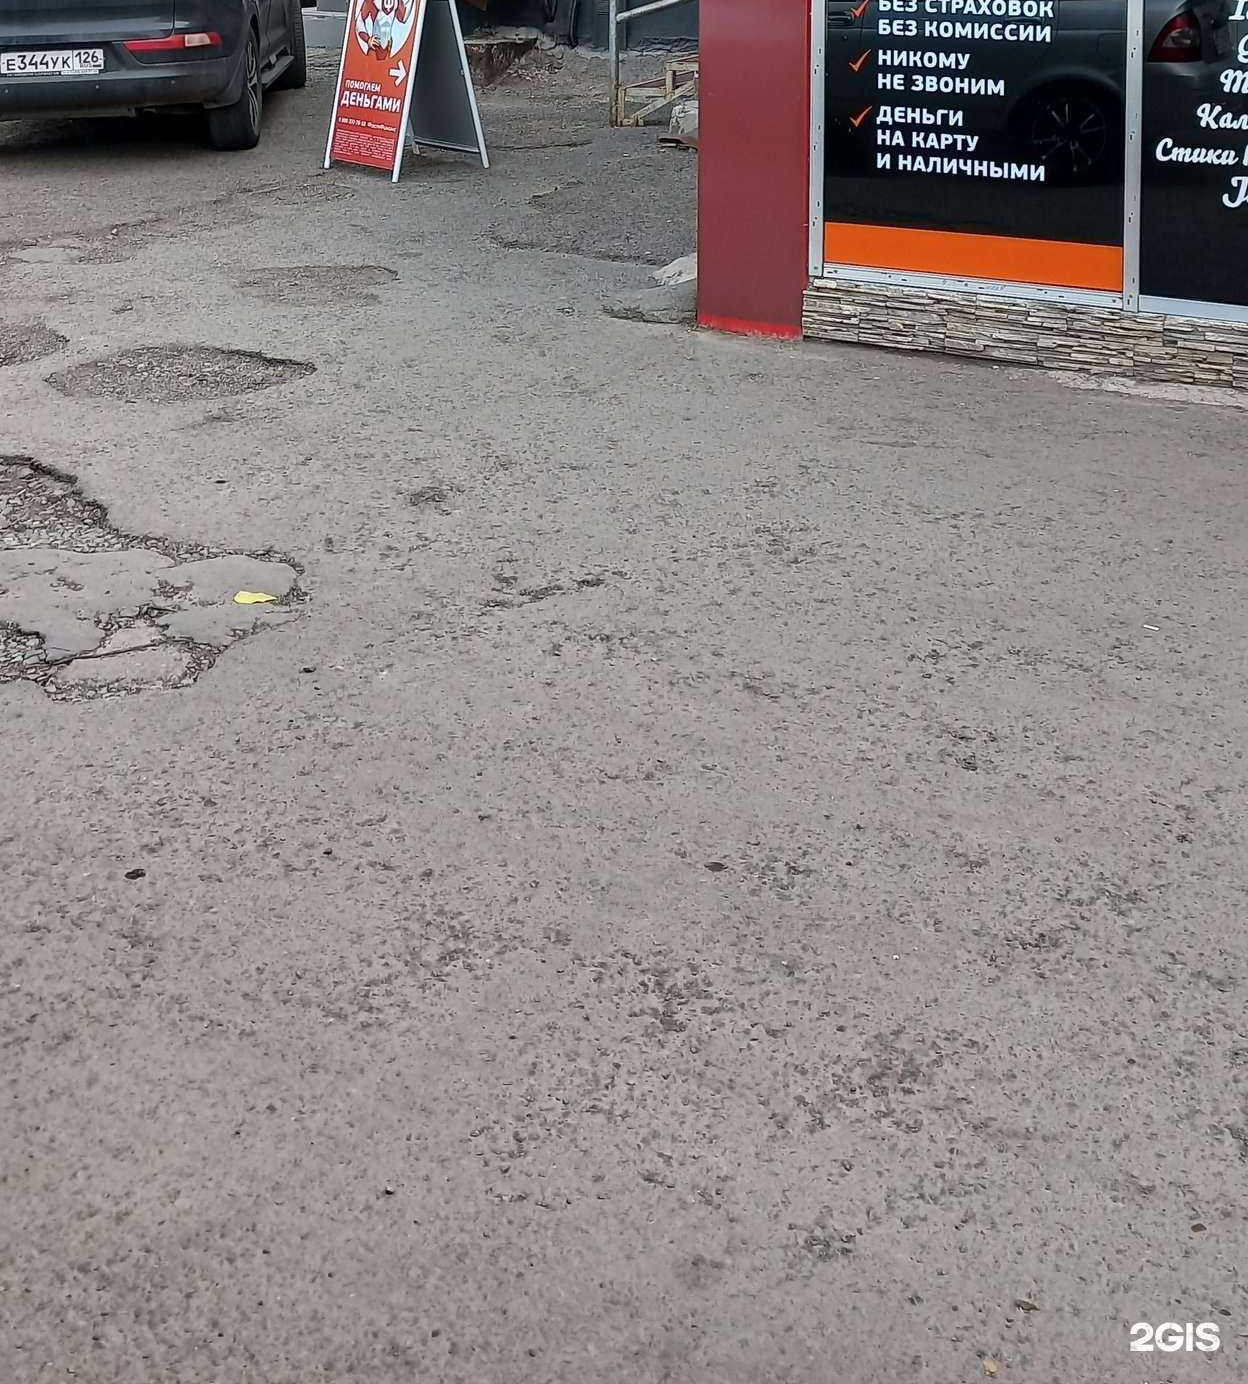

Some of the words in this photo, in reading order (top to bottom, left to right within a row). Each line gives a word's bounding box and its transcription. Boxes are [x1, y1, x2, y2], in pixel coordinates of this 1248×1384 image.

[878, 19, 918, 36] БЕЗ
[924, 21, 1052, 43] КОМИССИИ
[6, 53, 71, 71] Е344УК
[74, 50, 100, 64] 126
[877, 49, 970, 70] НИКОМУ
[345, 79, 381, 93] ПОМОГАЕМ
[877, 73, 905, 90] НЕ
[911, 75, 1005, 96] ЗВОНИМ
[340, 91, 401, 113] ДЕНЬГАМИ
[876, 105, 964, 127] ДЕНЬГИ
[877, 129, 905, 147] НА
[911, 131, 979, 152] КАРТУ
[876, 153, 891, 170] И
[898, 154, 1046, 182] НАЛИЧНЫМИ
